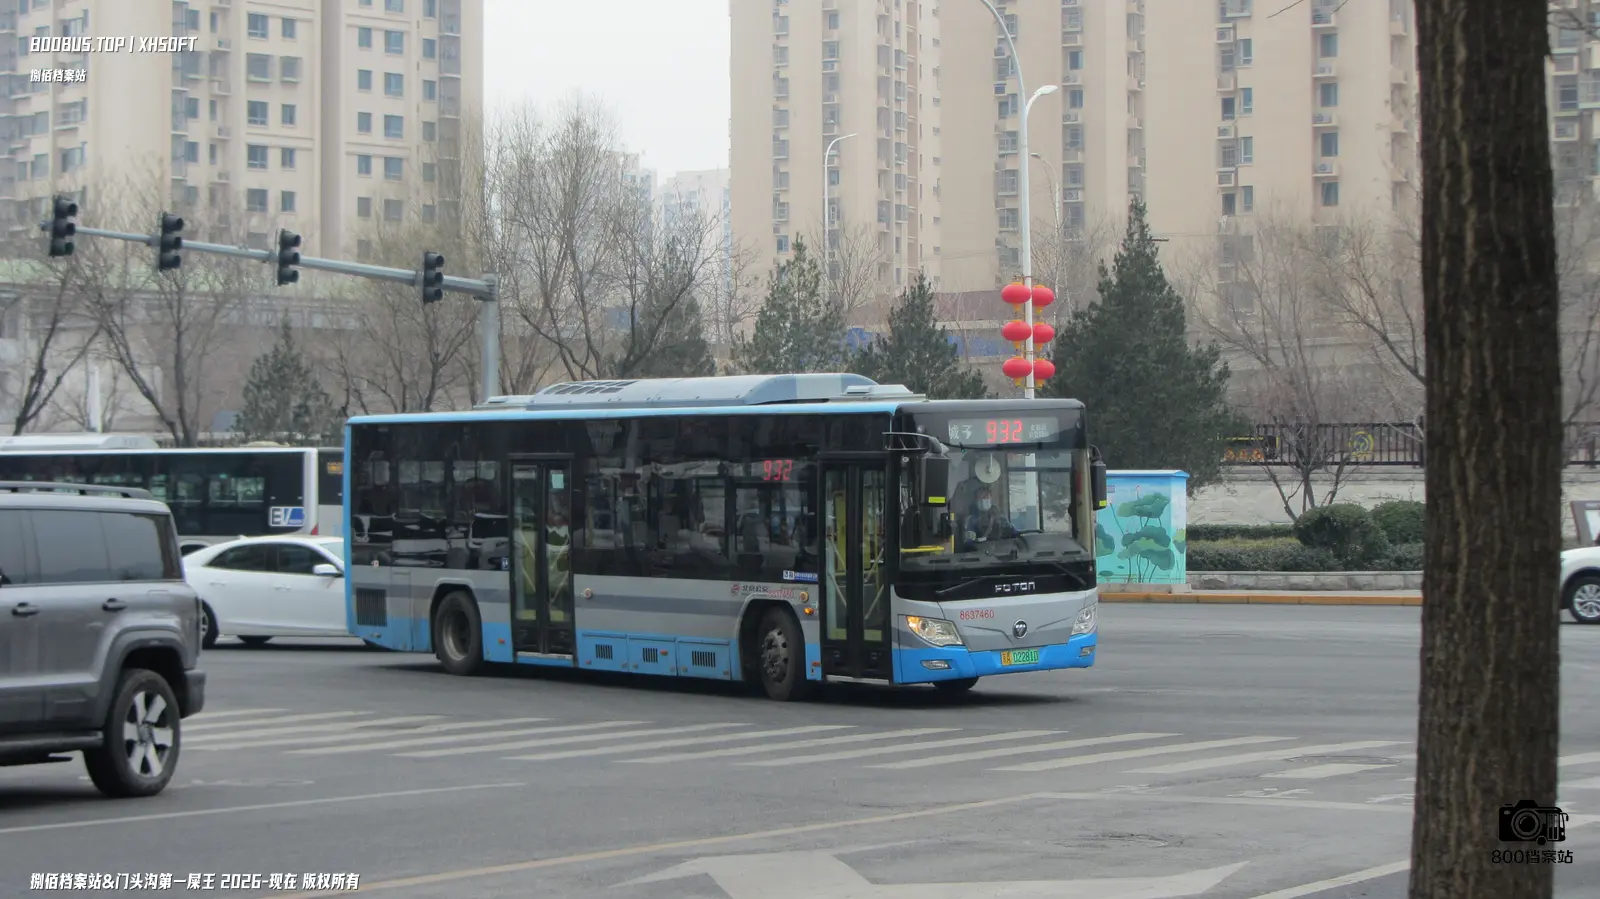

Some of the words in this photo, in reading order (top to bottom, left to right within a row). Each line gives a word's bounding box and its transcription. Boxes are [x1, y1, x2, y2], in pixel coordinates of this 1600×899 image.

[986, 419, 1024, 443] 932
[763, 459, 793, 480] 932
[271, 507, 293, 526] EV
[994, 581, 1036, 593] FOTON
[959, 610, 995, 620] 8637460
